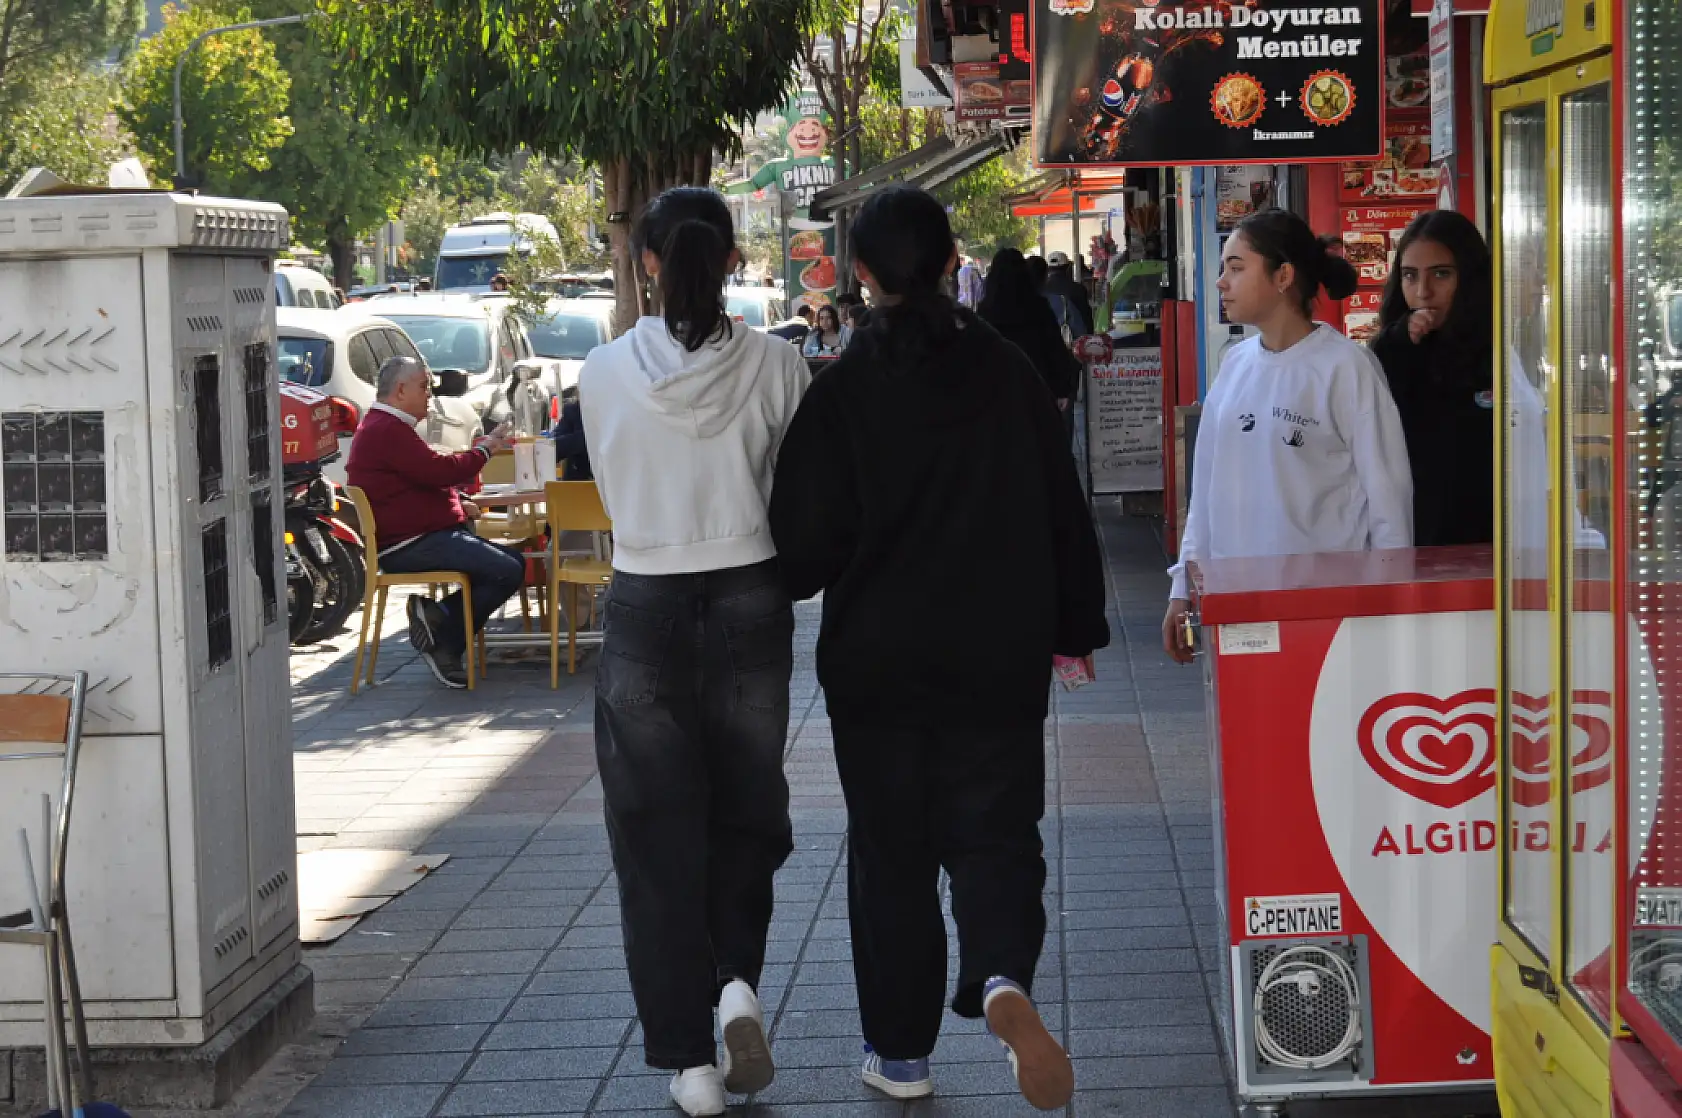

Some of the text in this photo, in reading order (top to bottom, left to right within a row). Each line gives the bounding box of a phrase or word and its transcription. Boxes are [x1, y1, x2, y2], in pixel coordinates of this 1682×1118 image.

[1134, 3, 1362, 32] Kolalı Doyuran
[1236, 34, 1362, 59] Menüler
[1371, 820, 1496, 857] ALGiD
[1249, 905, 1340, 934] C-PENTANE
